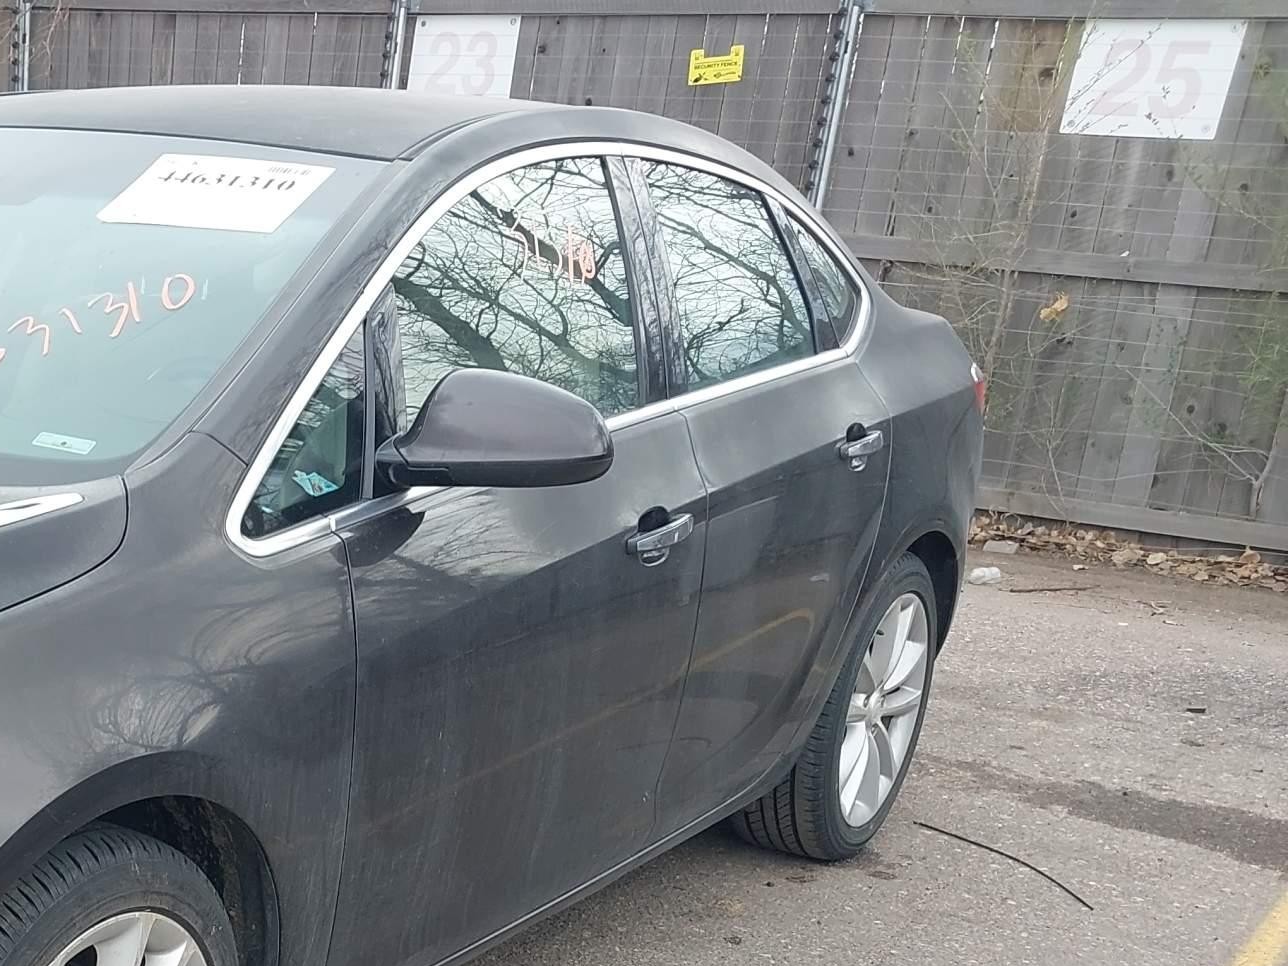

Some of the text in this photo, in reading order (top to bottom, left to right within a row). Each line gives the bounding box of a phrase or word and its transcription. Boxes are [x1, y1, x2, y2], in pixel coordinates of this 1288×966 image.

[423, 31, 498, 96] 23
[1093, 38, 1211, 119] 25
[158, 169, 297, 191] 44631310
